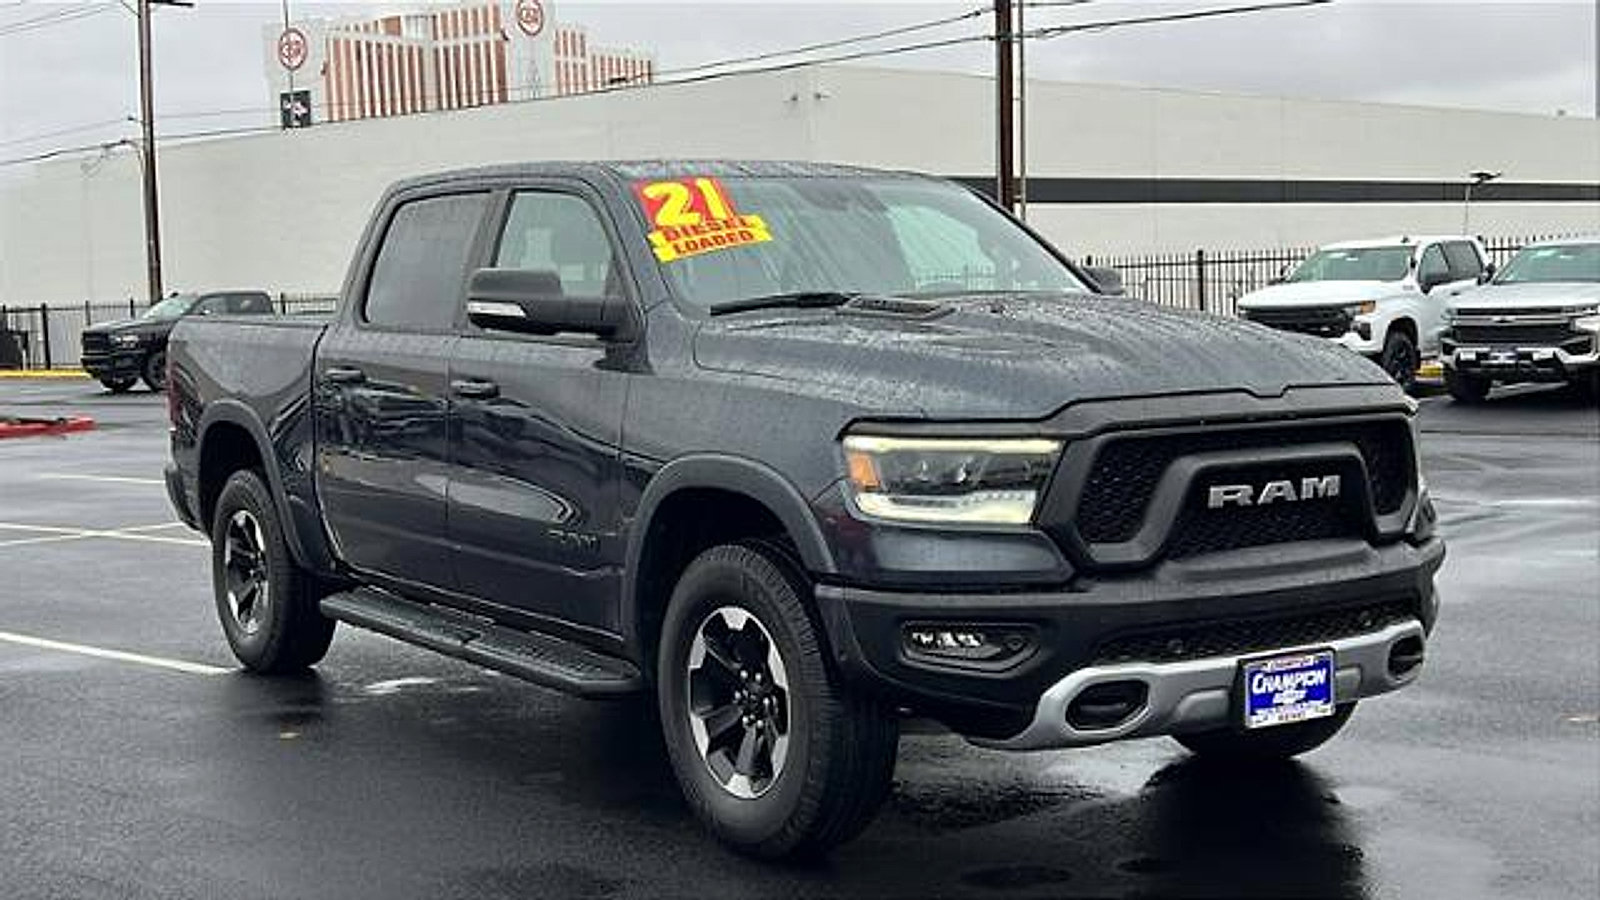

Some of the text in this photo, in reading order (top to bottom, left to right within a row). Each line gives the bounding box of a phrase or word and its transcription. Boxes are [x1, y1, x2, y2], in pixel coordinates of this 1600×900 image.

[642, 177, 727, 227] 21
[672, 230, 754, 254] LOADED
[1207, 474, 1341, 509] RAM
[1252, 667, 1327, 694] CHAMPION
